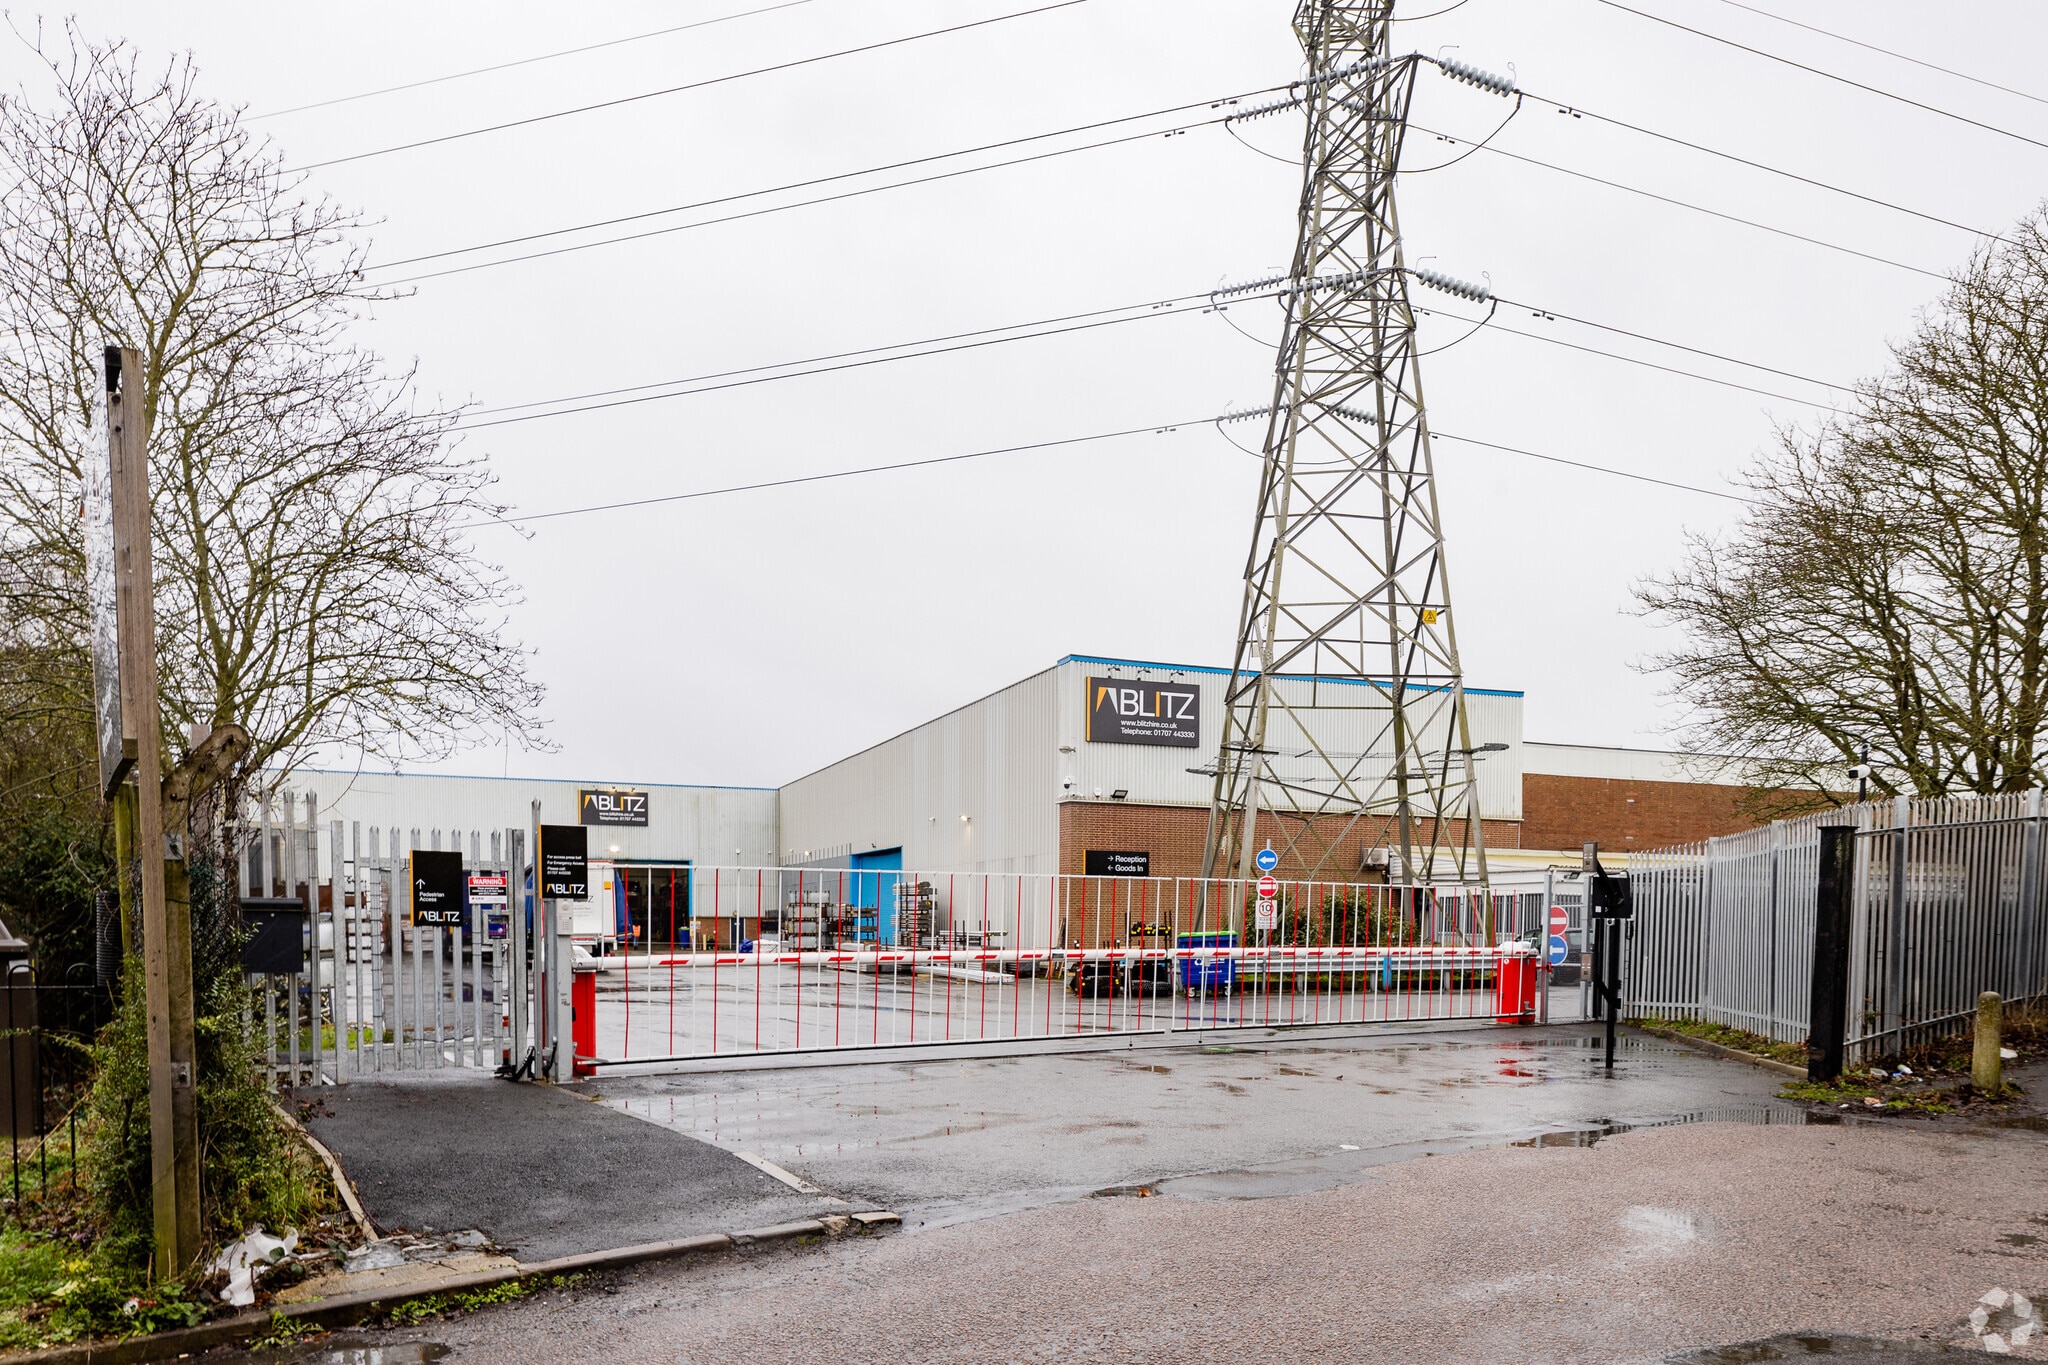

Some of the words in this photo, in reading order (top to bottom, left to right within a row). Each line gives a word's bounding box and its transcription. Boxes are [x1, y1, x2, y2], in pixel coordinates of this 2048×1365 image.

[1120, 720, 1178, 729] www.blitzhire.co.uk
[1120, 727, 1153, 737] Telephone:
[1153, 729, 1172, 737] 01707
[1115, 855, 1147, 864] Reception
[1115, 864, 1136, 872] Goods
[472, 878, 503, 886] WARNING
[1261, 904, 1272, 912] 10
